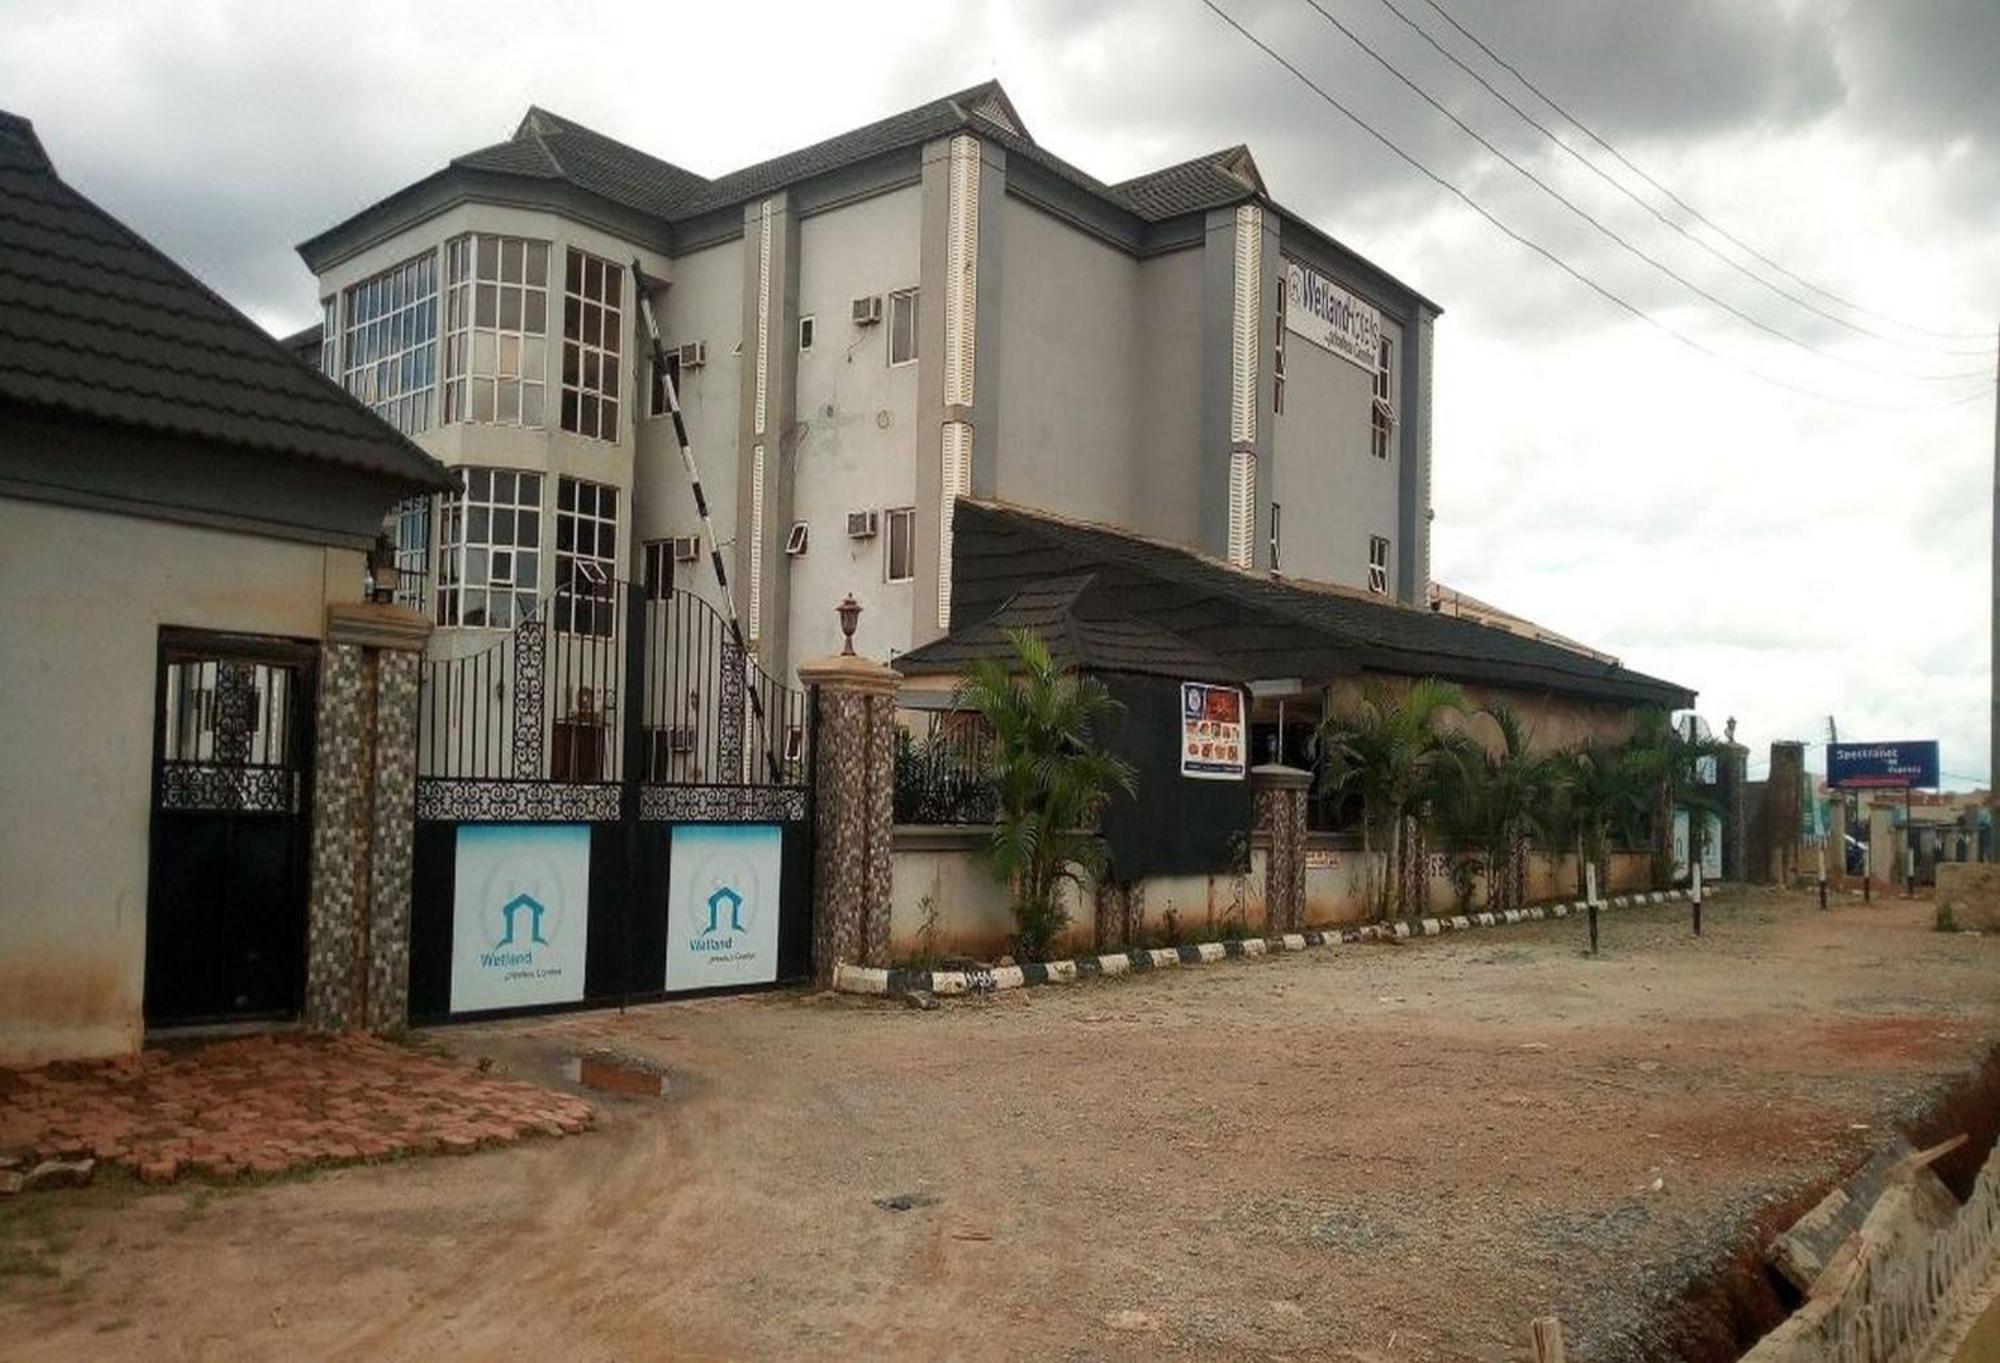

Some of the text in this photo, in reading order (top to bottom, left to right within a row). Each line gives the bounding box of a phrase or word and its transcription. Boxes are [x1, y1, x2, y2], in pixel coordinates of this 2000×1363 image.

[1302, 268, 1349, 333] Wetland
[690, 936, 733, 952] Wetland
[480, 950, 533, 968] Wetland
